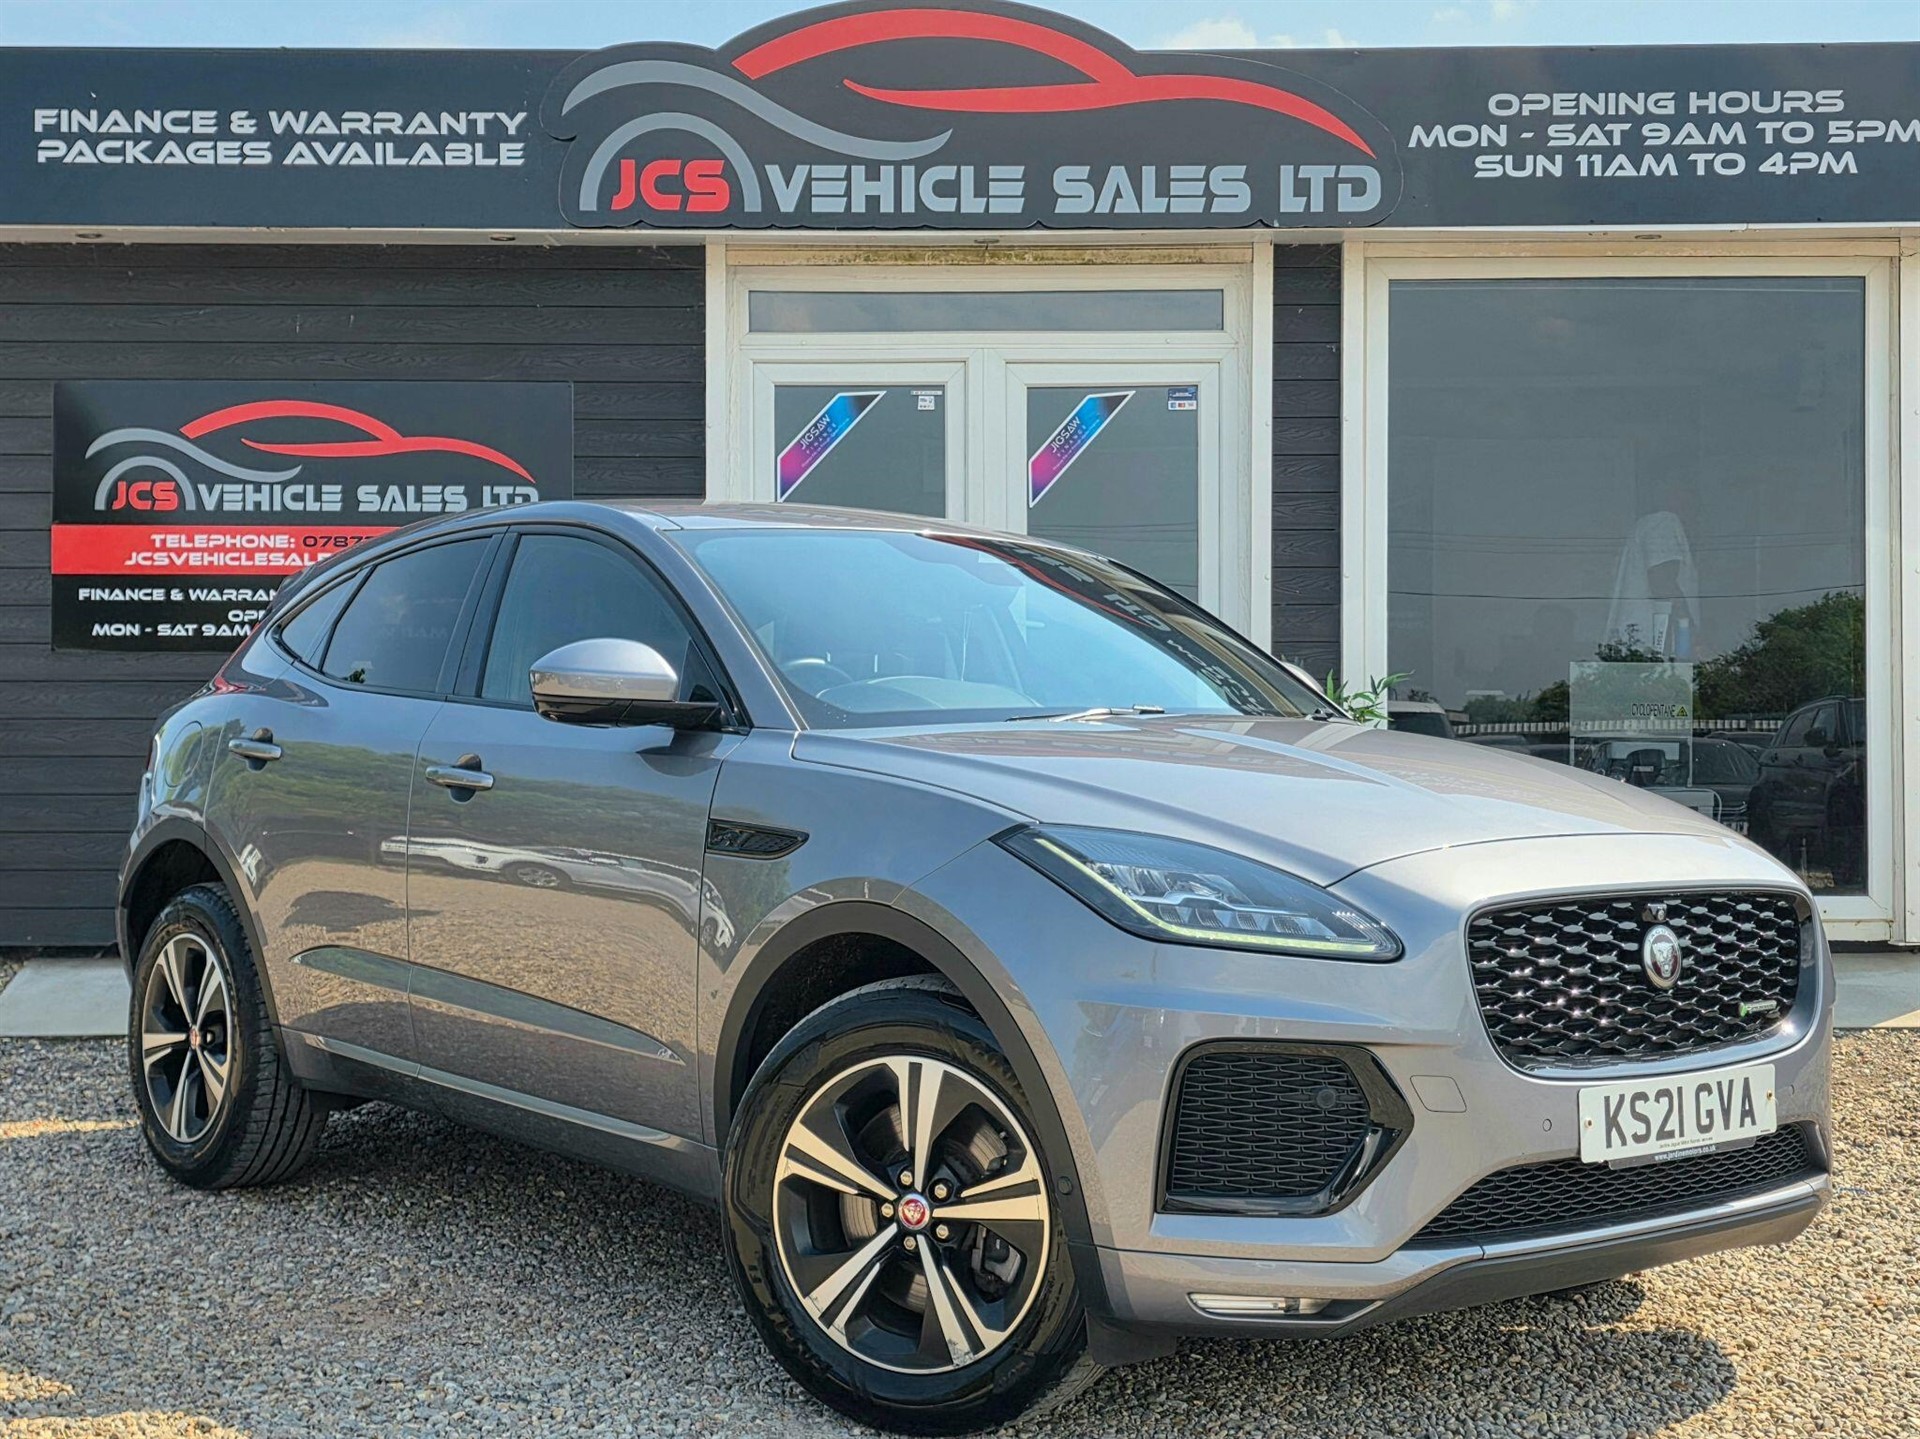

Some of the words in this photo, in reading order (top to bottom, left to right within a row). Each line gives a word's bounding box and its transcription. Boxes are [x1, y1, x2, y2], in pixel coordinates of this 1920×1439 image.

[1488, 91, 1676, 117] OPENING
[1689, 89, 1845, 115] HOURS
[34, 108, 218, 133] FINANCE
[230, 110, 257, 133] &
[268, 111, 528, 135] WARRANTY
[1408, 124, 1508, 148] MON
[1547, 123, 1632, 147] SAT
[1642, 122, 1747, 146] 9AM
[1755, 120, 1815, 145] TO
[1827, 119, 1920, 143] 5PM
[36, 140, 272, 165] PACKAGES
[282, 142, 526, 166] AVAILABLE
[1474, 154, 1563, 178] SUN
[1575, 153, 1679, 177] 11AM
[1687, 152, 1747, 177] TO
[1758, 151, 1859, 175] 4PM
[610, 158, 731, 212] JCS
[763, 164, 1026, 214] VEHICLE
[1052, 165, 1252, 214] SALES
[1278, 165, 1383, 213] LTD
[799, 413, 831, 451] JIGSAW
[112, 480, 178, 511] JCS
[197, 483, 342, 512] VEHICLE
[356, 485, 468, 513] SALES
[482, 485, 539, 508] LTD
[151, 534, 296, 549] TELEPHONE:
[302, 535, 375, 548] 0787
[78, 588, 167, 602] FINANCE
[170, 588, 183, 602] &
[92, 623, 140, 637] MON
[157, 623, 198, 637] SAT
[201, 623, 252, 637] 9AM
[1631, 703, 1676, 718] CYCLOPENTANE
[1603, 1086, 1686, 1149] KS21
[1694, 1076, 1757, 1135] GVA
